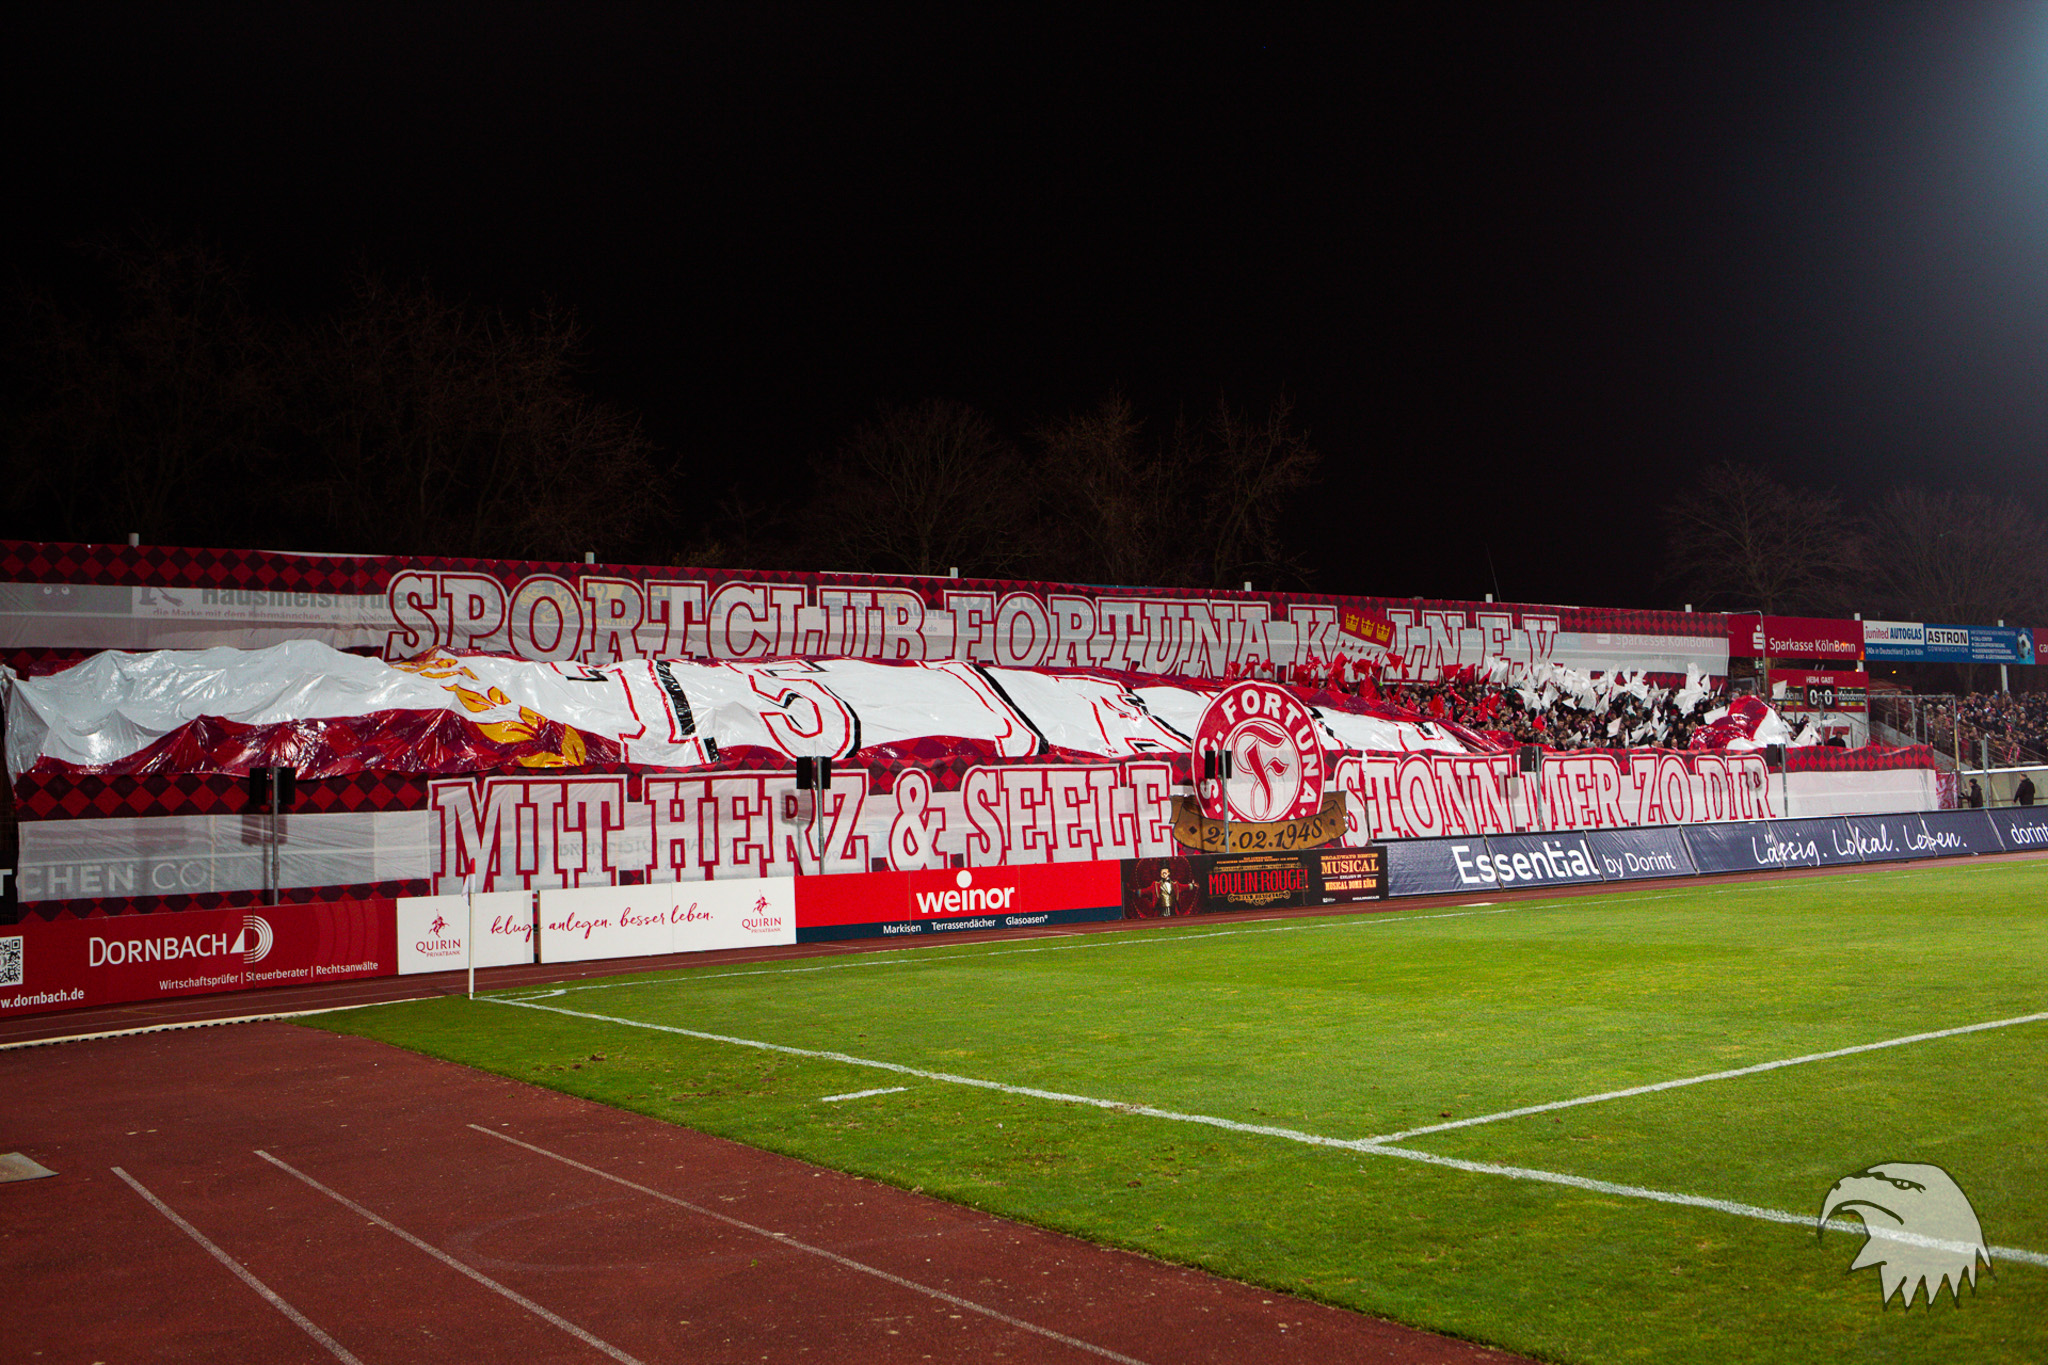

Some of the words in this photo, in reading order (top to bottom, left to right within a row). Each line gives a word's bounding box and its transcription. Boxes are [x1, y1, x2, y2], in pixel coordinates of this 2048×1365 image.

[387, 571, 926, 664] SPORTCLUB
[944, 590, 1278, 679] FORTUNA
[1288, 604, 1467, 686] KLN
[1890, 627, 1923, 640] AUTOGLAS
[1927, 630, 1968, 645] ASTRON
[1769, 637, 1814, 653] Sparkasse
[1815, 639, 1856, 653] KölnBonn
[1221, 689, 1320, 803] FORTUNA
[428, 773, 628, 896] MIT
[642, 768, 872, 882] HERZ
[889, 762, 948, 872] &
[960, 760, 1176, 868] SEELE
[1334, 754, 1517, 847] STONN
[1517, 754, 1630, 832] MER
[1630, 753, 1694, 826] ZO
[1695, 754, 1776, 822] DIR
[1752, 832, 1828, 867] Lässig.
[1833, 823, 1900, 856] Lokal.
[1320, 859, 1379, 875] MUSICAL
[1451, 839, 1601, 884] Essential
[1602, 854, 1623, 878] by
[1624, 852, 1677, 873] Dorint
[916, 870, 1015, 914] weinor
[1208, 871, 1258, 896] MOULIN
[1260, 868, 1308, 892] ROUGE!
[549, 911, 612, 940] anlegen.
[619, 906, 666, 928] besser
[671, 902, 715, 925] leben.
[742, 917, 782, 930] QUIRIN
[883, 923, 922, 934] Markisen
[931, 917, 996, 931] Terrassendächer
[416, 938, 461, 954] QUIRIN
[426, 950, 461, 958] PRIVATBANK
[159, 974, 239, 991] Wirtschaftsprüfer
[245, 967, 309, 982] Steuerberater
[316, 961, 379, 976] Rechtsanwälte
